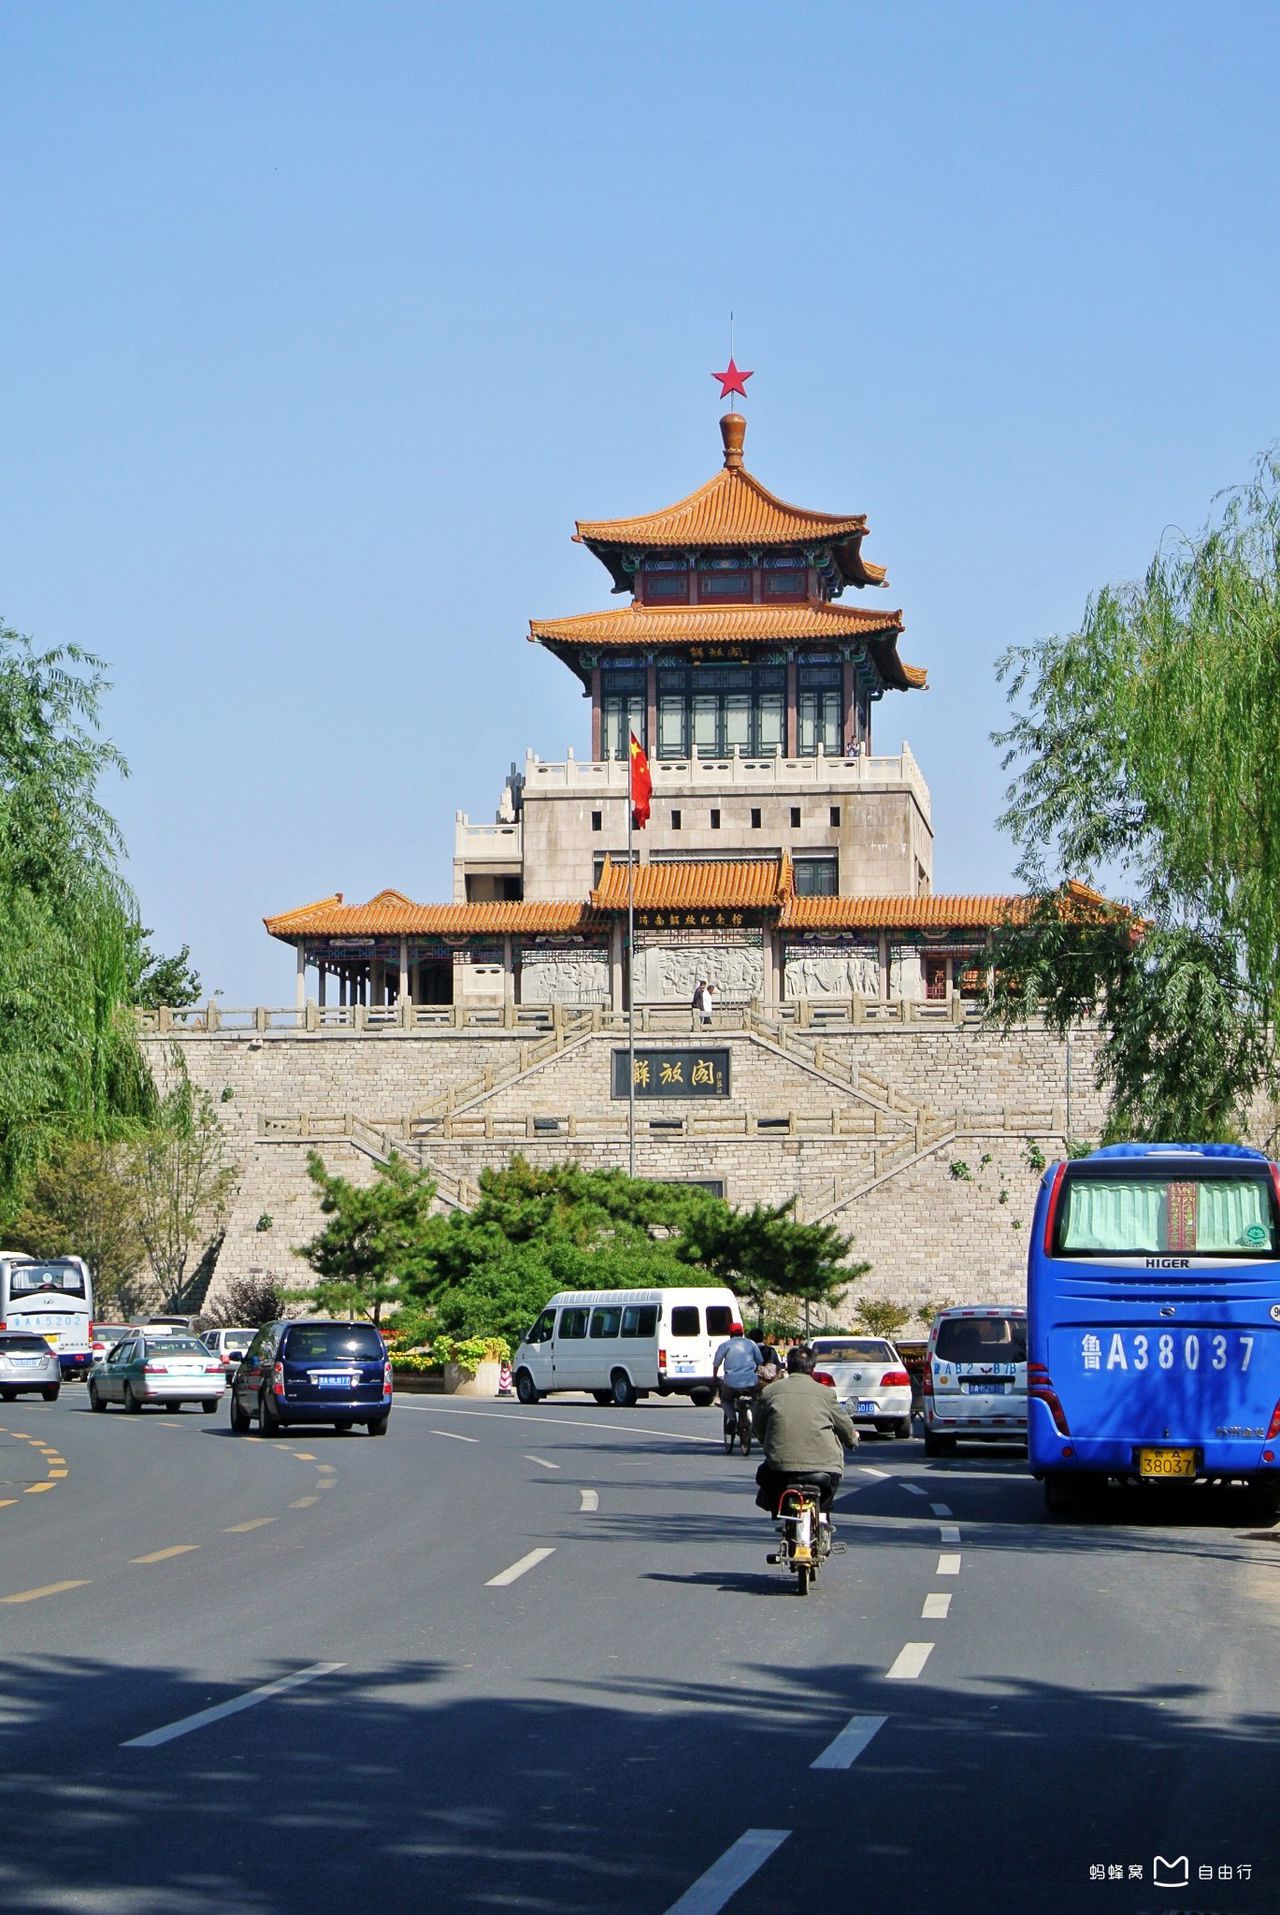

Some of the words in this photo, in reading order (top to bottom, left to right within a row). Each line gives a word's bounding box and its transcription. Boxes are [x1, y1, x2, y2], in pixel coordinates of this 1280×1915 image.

[1146, 1259, 1189, 1268] HIGER
[1082, 1334, 1254, 1371] 鲁A38037
[1144, 1459, 1191, 1473] 38037
